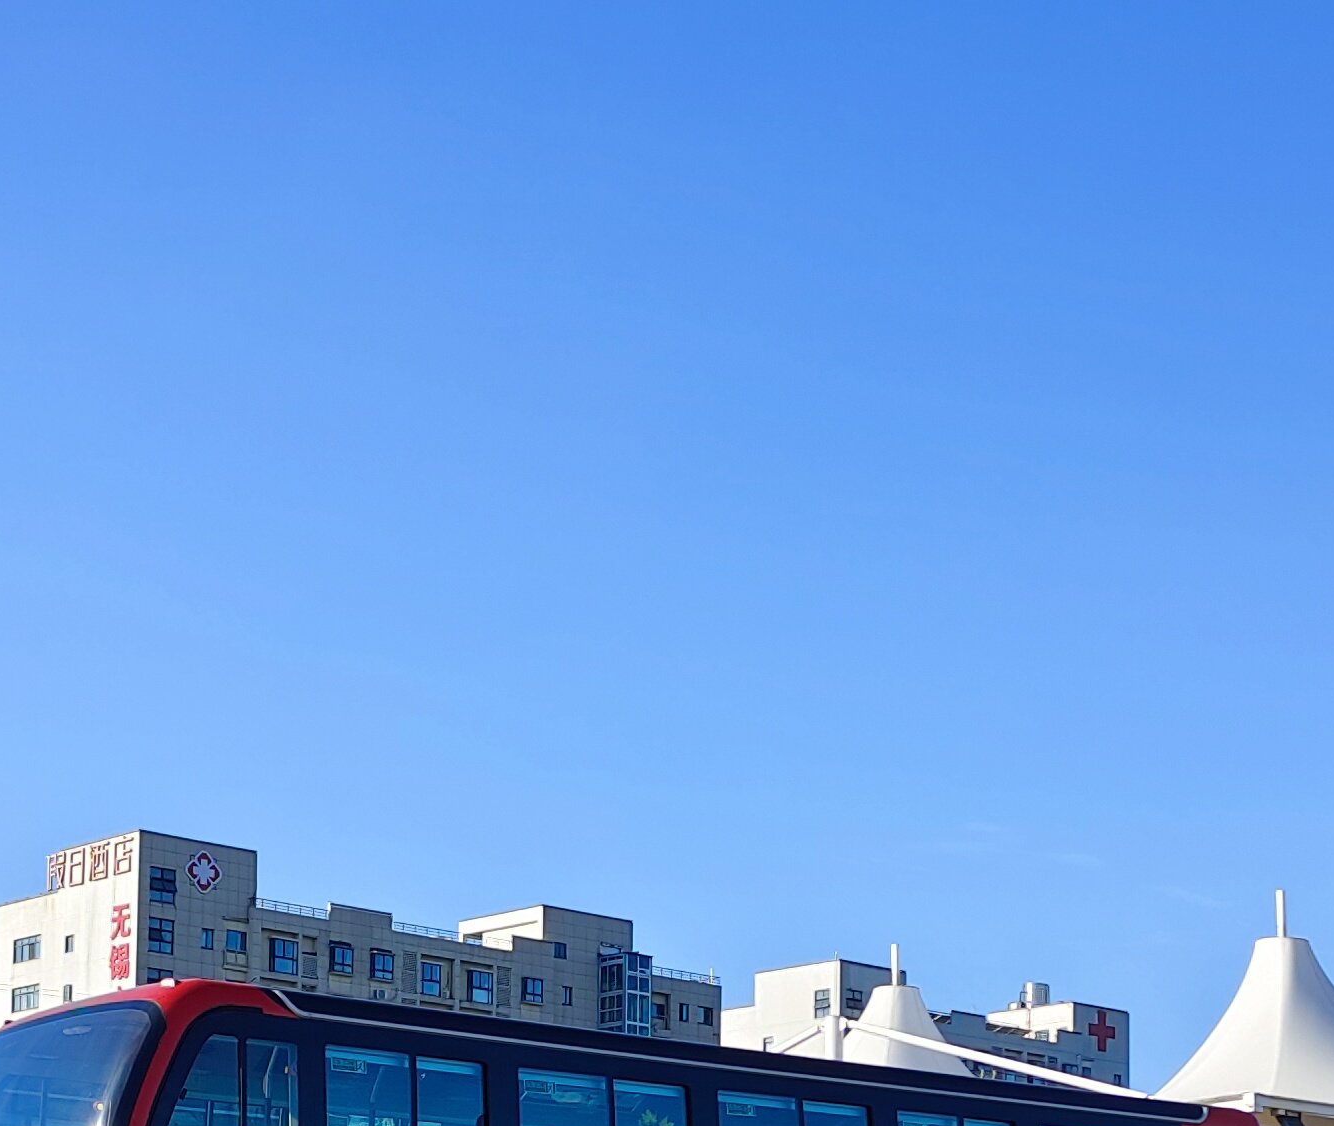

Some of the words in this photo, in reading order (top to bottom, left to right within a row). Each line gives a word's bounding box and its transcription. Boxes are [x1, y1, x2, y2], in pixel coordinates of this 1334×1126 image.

[46, 835, 134, 891] 假日酒店
[109, 903, 132, 990] 无锡
